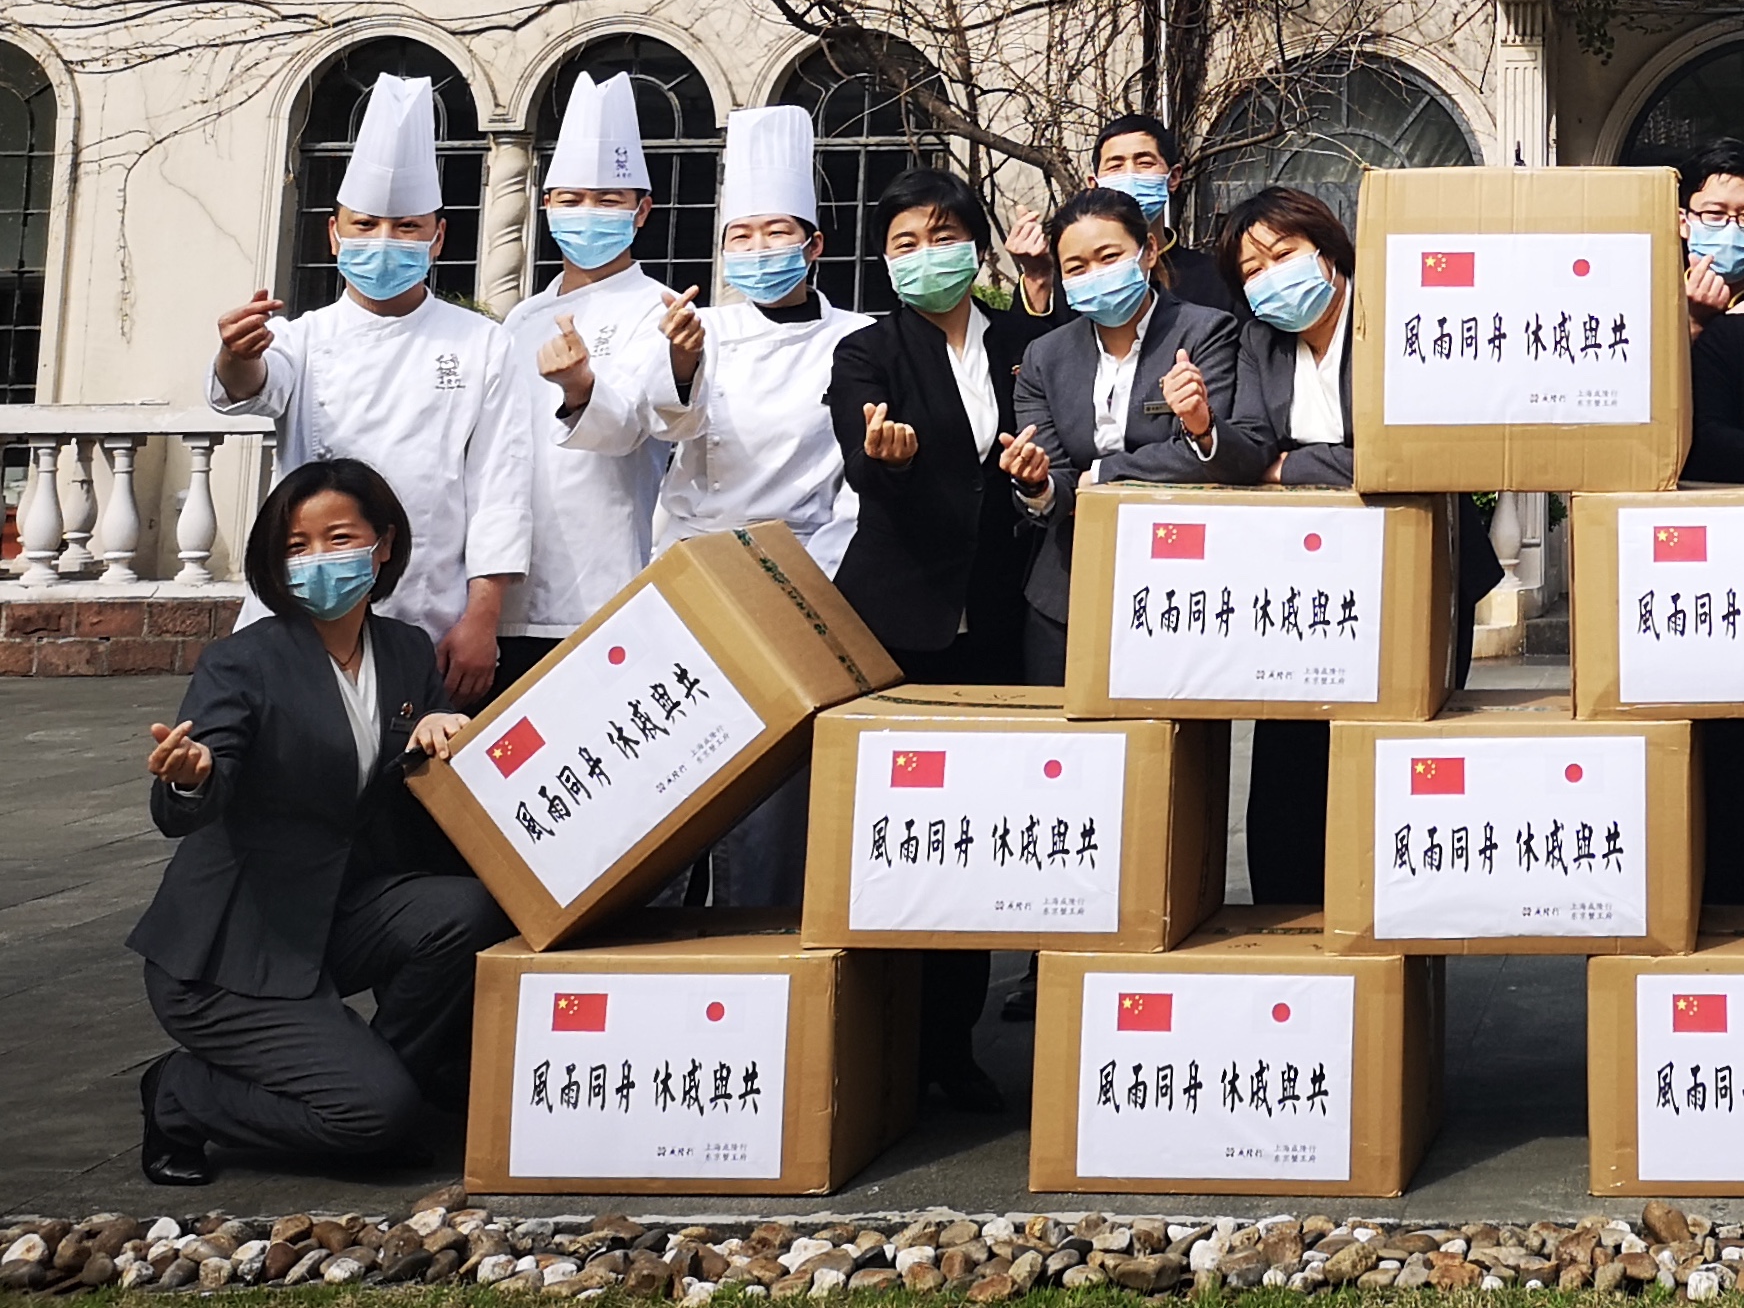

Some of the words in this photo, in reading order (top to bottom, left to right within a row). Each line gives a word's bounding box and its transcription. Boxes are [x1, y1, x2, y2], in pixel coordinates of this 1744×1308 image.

[1403, 312, 1507, 364] 風雨同舟
[1130, 586, 1235, 638] 風雨同舟
[1638, 588, 1741, 641] 風雨同舟
[515, 745, 613, 845] 風雨同舟
[869, 815, 974, 868] 風雨同舟
[1393, 821, 1498, 876] 風雨同舟
[530, 1059, 635, 1114] 風雨同舟
[1097, 1059, 1203, 1114] 風雨同舟
